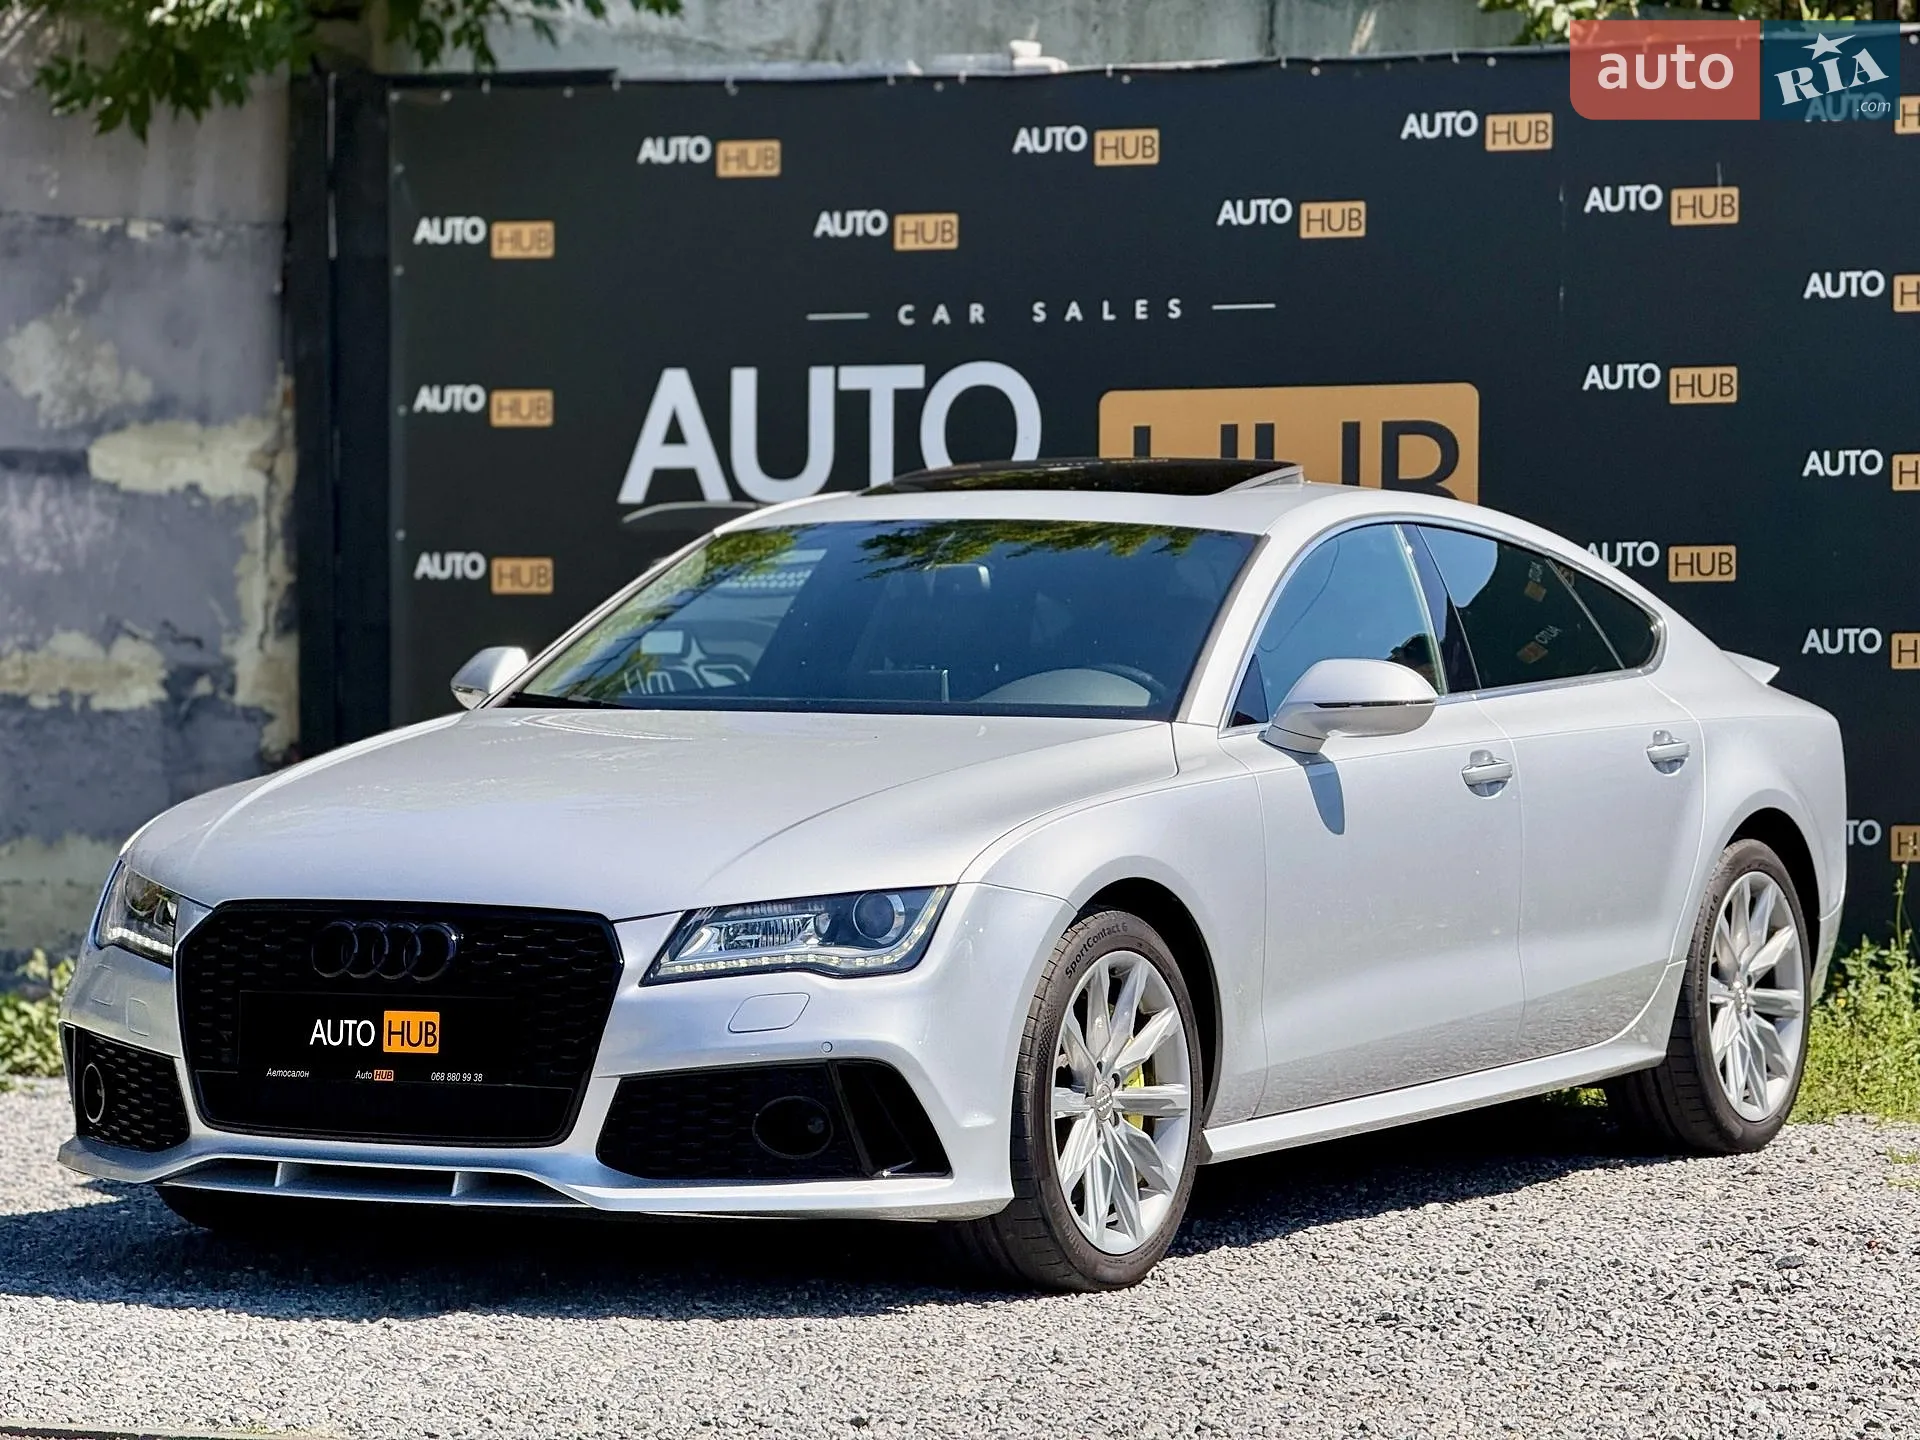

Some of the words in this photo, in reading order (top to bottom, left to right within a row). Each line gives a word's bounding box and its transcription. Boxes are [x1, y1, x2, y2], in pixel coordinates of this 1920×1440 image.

[1012, 125, 1088, 154] AUTO
[1100, 136, 1156, 160] HUB
[1401, 110, 1478, 140] AUTO
[1491, 120, 1547, 145] HUB
[637, 136, 712, 164] AUTO
[723, 147, 777, 171] HUB
[1217, 198, 1293, 226] AUTO
[1306, 208, 1362, 233] HUB
[1584, 184, 1663, 213] AUTO
[1676, 194, 1736, 219] HUB
[413, 217, 487, 245] AUTO
[497, 228, 552, 252] HUB
[814, 210, 889, 237] AUTO
[900, 220, 955, 245] HUB
[1803, 270, 1886, 299] AUTO
[898, 304, 985, 325] CAR
[1032, 298, 1182, 323] SALES
[1582, 363, 1661, 391] AUTO
[1675, 374, 1734, 399] HUB
[413, 385, 486, 413] AUTO
[496, 396, 551, 421] HUB
[617, 361, 1042, 504] AUTO
[1802, 449, 1884, 477] AUTO
[414, 552, 486, 580] AUTO
[498, 564, 551, 589] HUB
[1675, 552, 1733, 577] HUB
[1802, 627, 1882, 655] AUTO
[1846, 820, 1882, 846] TO
[1065, 922, 1121, 979] SportContact
[309, 1019, 375, 1047] AUTO
[387, 1020, 437, 1047] HUB
[266, 1068, 310, 1078] Автосалон
[355, 1070, 373, 1080] Auto
[375, 1071, 393, 1080] HUB
[431, 1072, 446, 1081] 068
[462, 1073, 472, 1082] 99
[473, 1073, 483, 1082] 38
